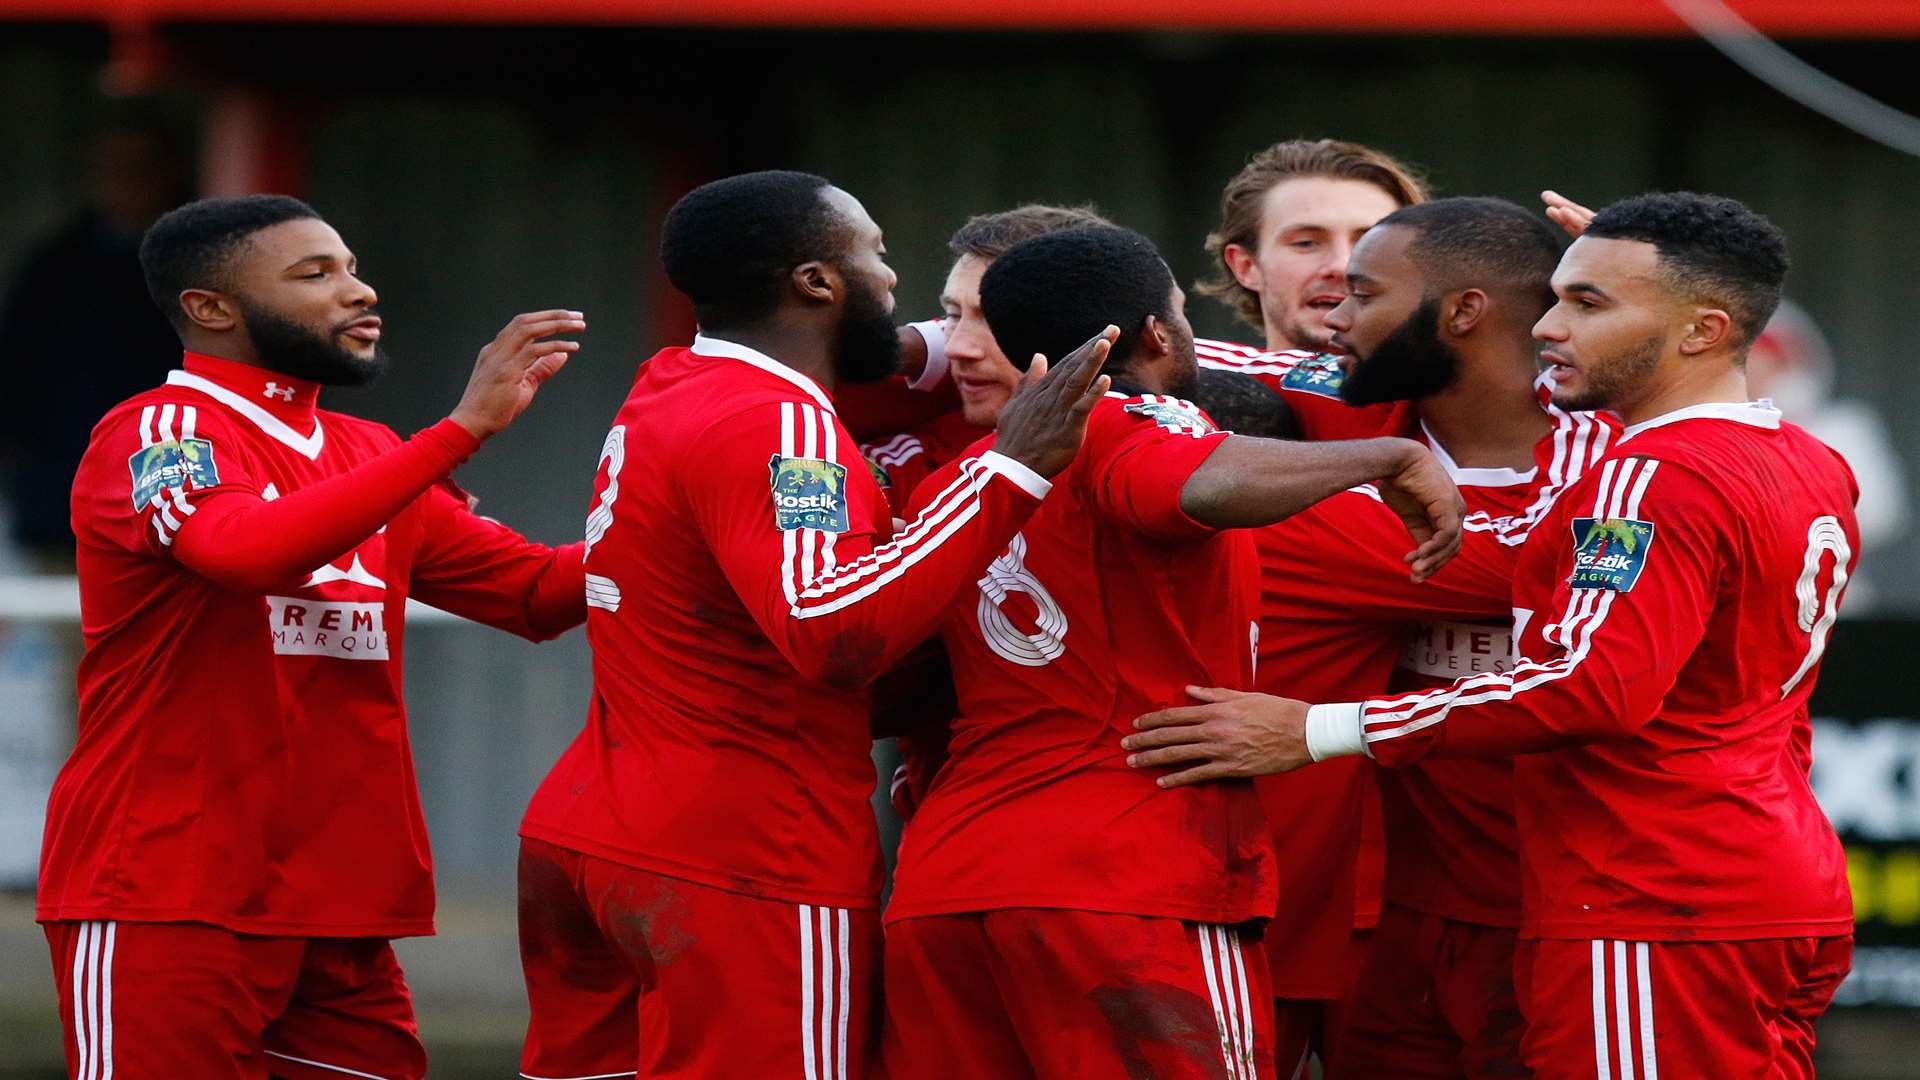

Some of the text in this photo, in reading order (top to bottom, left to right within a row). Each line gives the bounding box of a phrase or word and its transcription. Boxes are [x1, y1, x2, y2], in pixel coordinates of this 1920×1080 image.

[782, 515, 838, 527] EAGUE
[1573, 573, 1623, 584] EAGUE
[266, 604, 386, 632] REM
[272, 631, 389, 652] MARQU
